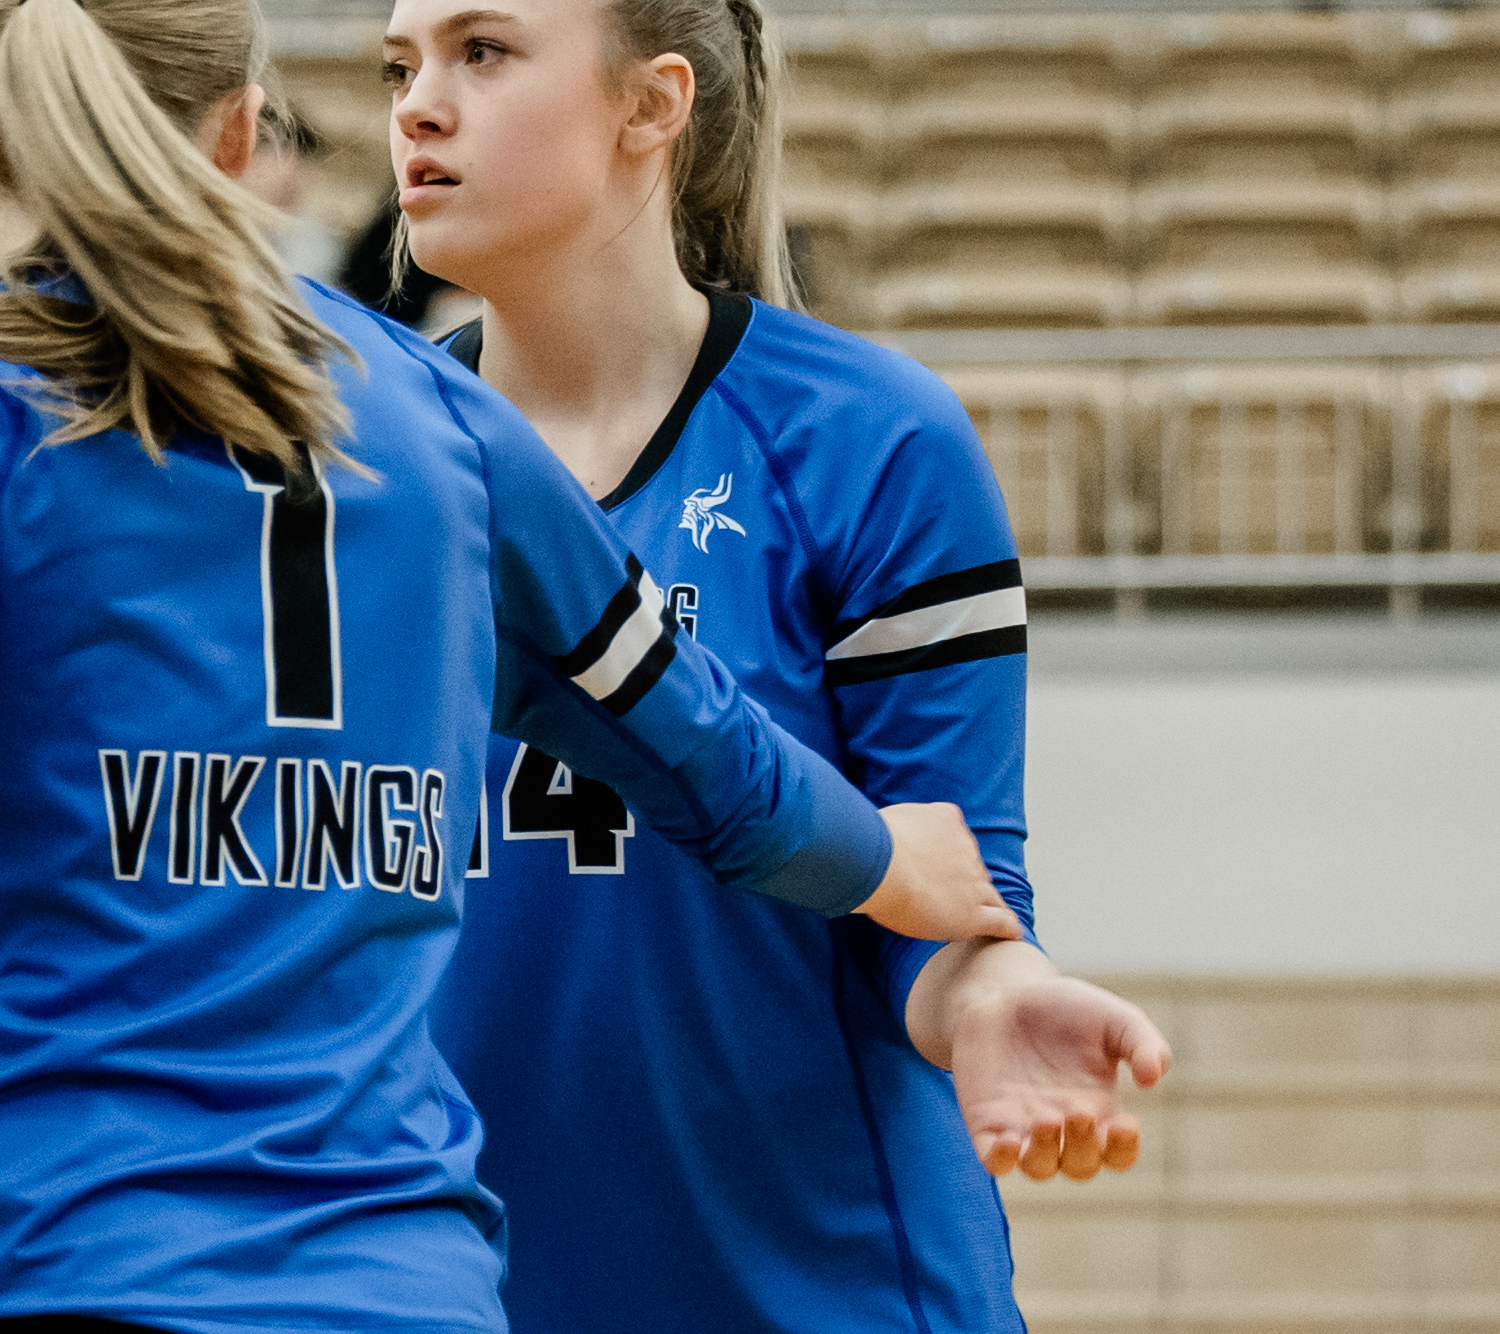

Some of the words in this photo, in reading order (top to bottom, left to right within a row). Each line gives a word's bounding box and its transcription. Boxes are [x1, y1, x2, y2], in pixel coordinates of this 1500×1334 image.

[230, 439, 343, 729] 1
[98, 750, 446, 902] VIKINGS
[463, 741, 636, 879] 4
